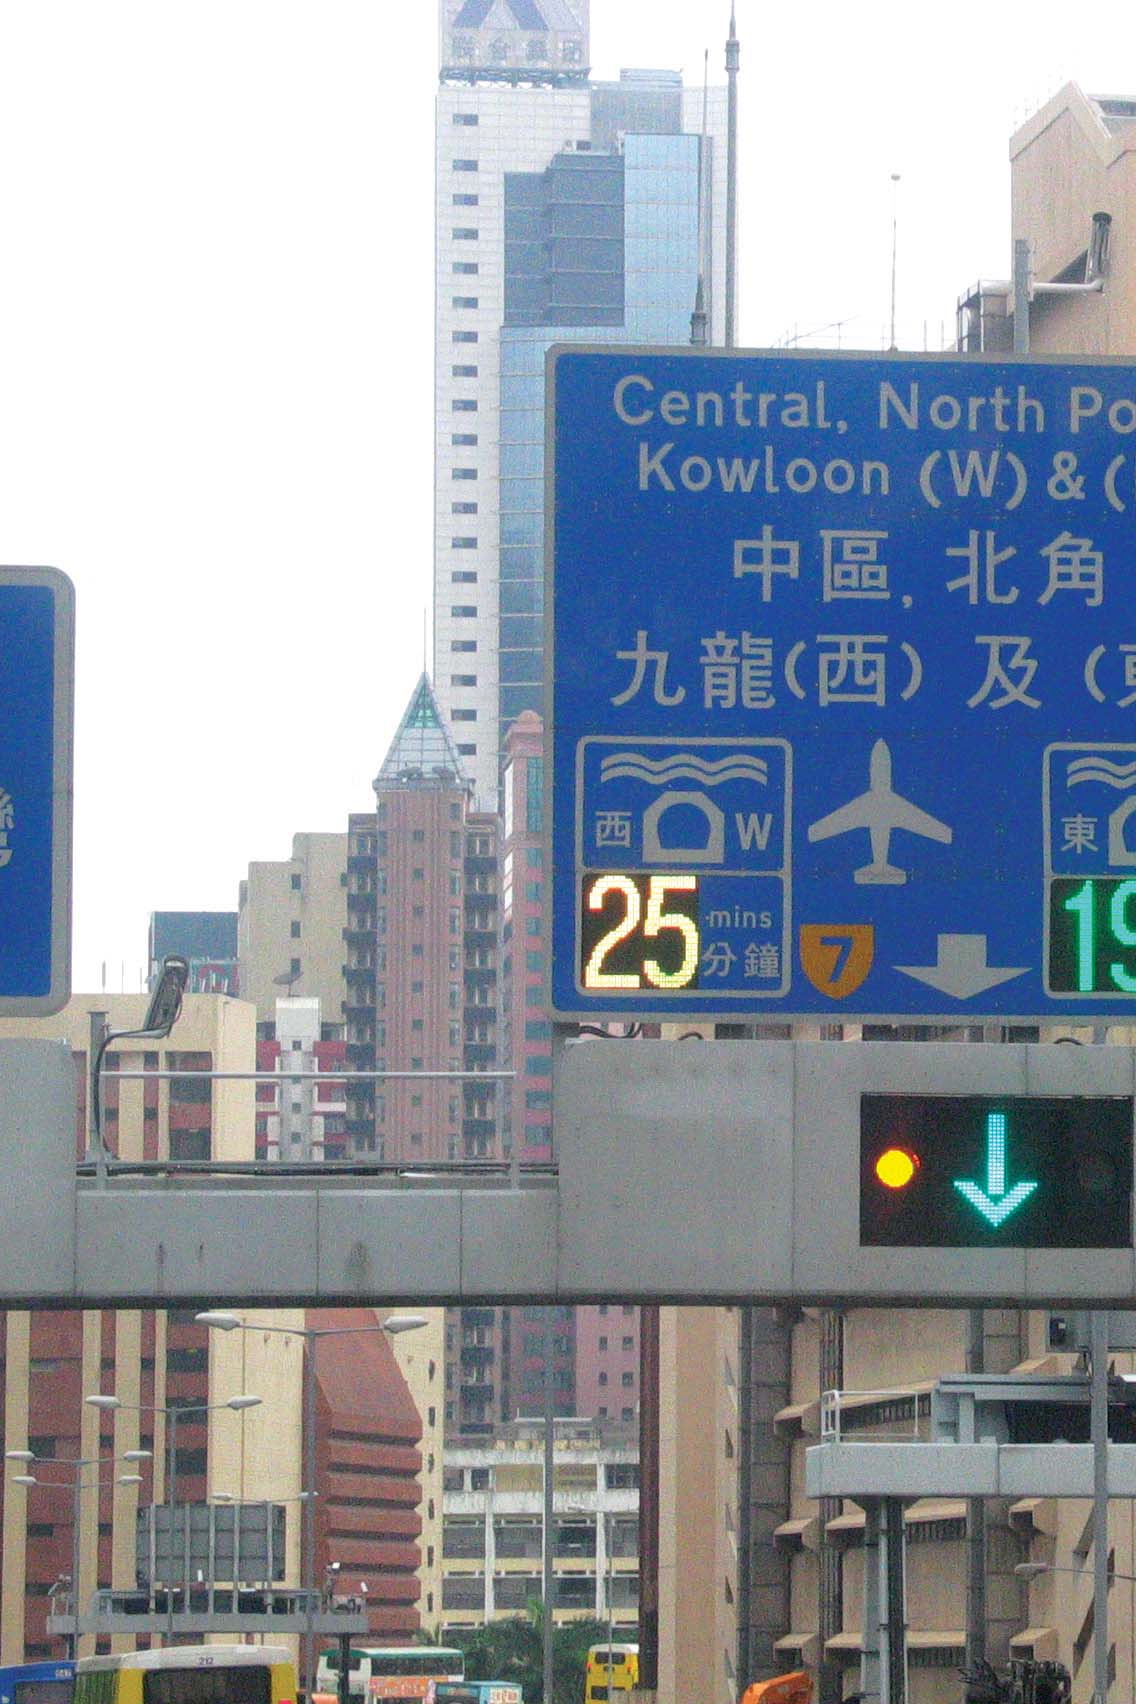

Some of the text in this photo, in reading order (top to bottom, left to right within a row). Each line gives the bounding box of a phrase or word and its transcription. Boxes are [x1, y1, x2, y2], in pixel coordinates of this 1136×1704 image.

[613, 375, 848, 433] Central,
[879, 382, 1046, 432] North
[638, 443, 890, 495] Kowloon
[919, 449, 1028, 510] (W)
[1047, 451, 1086, 501] &
[732, 525, 1105, 608] 中區, 北角
[967, 635, 1042, 709] 及
[594, 811, 633, 848] 西
[735, 812, 774, 850] W
[1060, 814, 1098, 853] 東
[585, 875, 699, 989] 25
[709, 905, 773, 928] mins
[702, 941, 780, 979] 分鐘
[820, 936, 855, 982] 7
